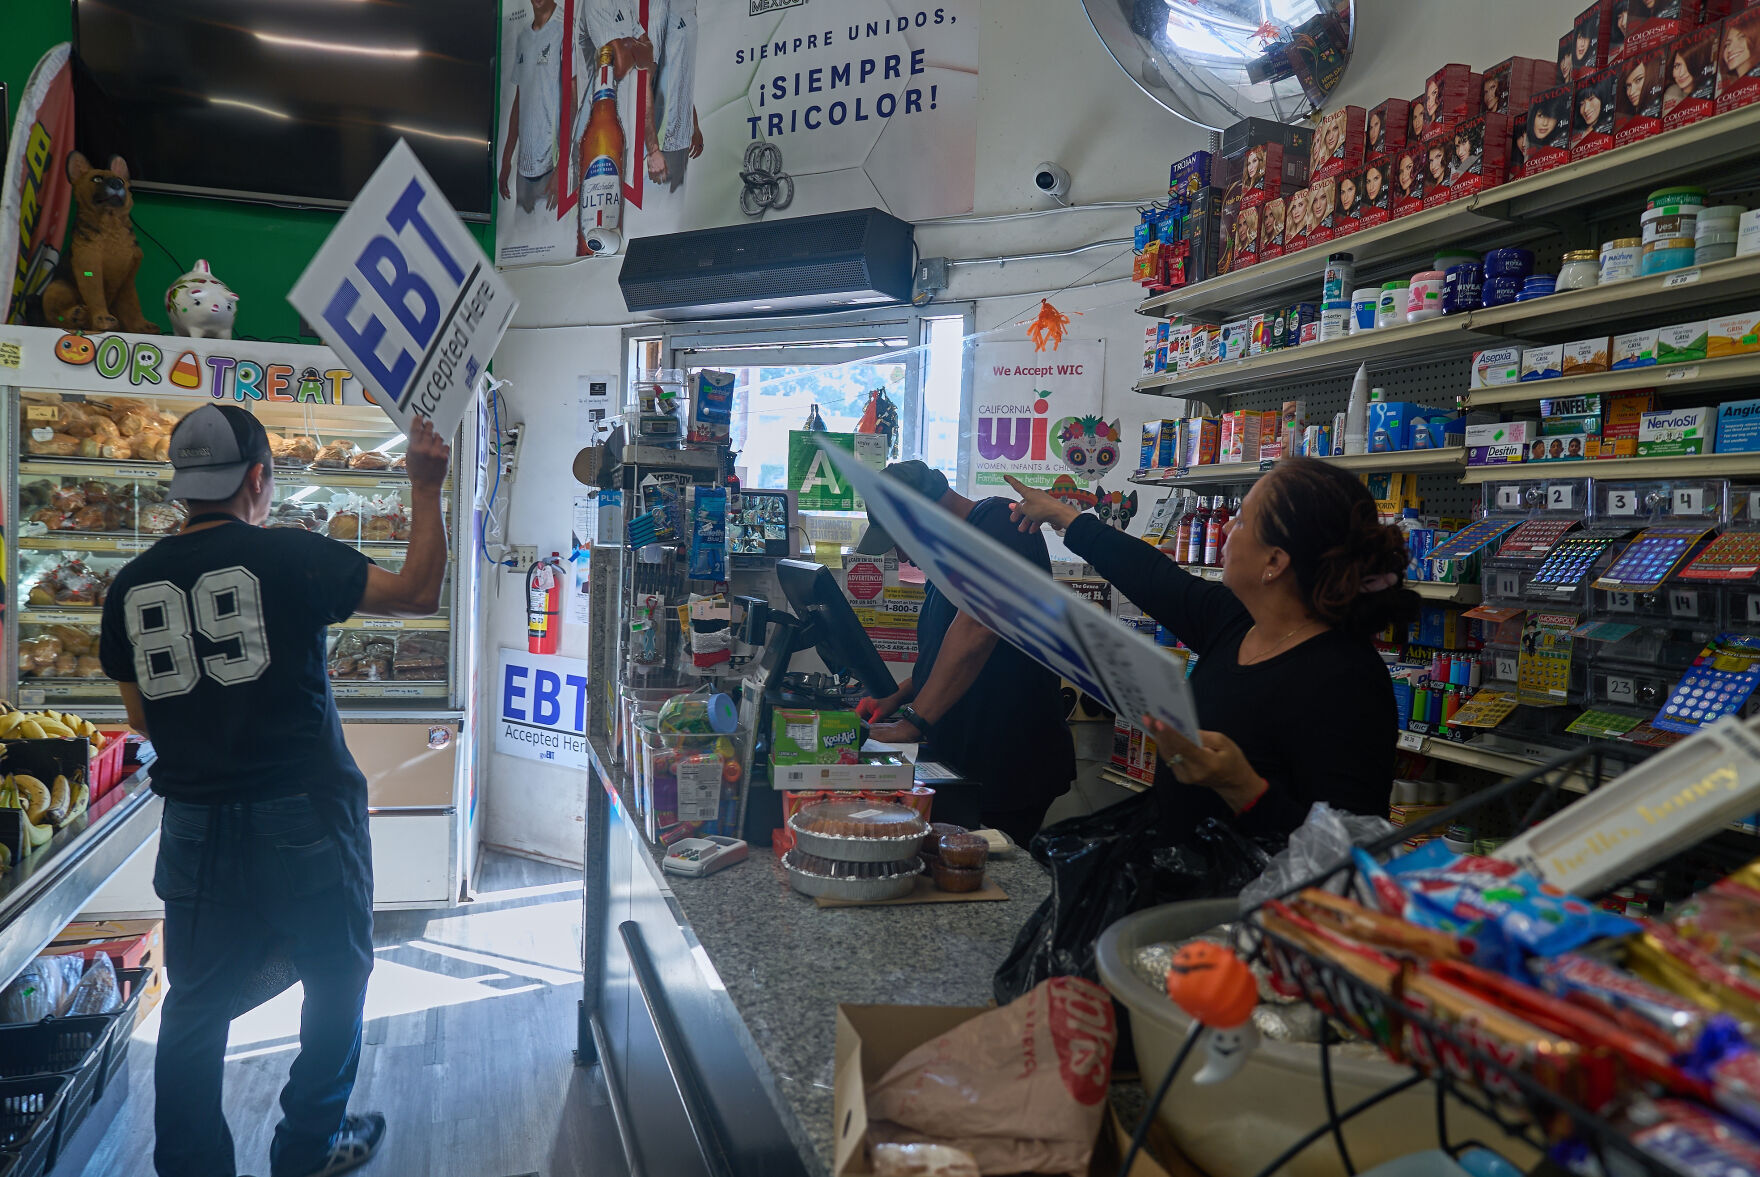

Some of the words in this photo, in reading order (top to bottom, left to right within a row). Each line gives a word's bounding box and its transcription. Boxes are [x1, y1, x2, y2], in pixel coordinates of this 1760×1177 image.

[1575, 4, 1599, 25] REVLON
[735, 31, 833, 64] SIEMPRE
[849, 8, 957, 41] UNIDOS,
[1627, 22, 1675, 43] COLORSILK
[1670, 28, 1717, 53] REVLON
[759, 49, 925, 107] ¡SIEMPRE
[1578, 69, 1617, 89] REVLON
[1531, 86, 1571, 104] REVLON
[1717, 83, 1760, 104] COLORSIL
[747, 85, 938, 139] TRICOLOR!
[1323, 110, 1346, 124] REVLON
[1663, 102, 1709, 123] COLORSILK
[1615, 120, 1656, 140] COLORSILK
[1572, 138, 1610, 154] COLORSILK
[1173, 155, 1197, 172] TROJAN
[1526, 151, 1565, 167] COLORSILK
[1310, 177, 1335, 192] REVLON
[1451, 177, 1479, 192] COLORSILK
[583, 192, 620, 209] ULTRA
[1394, 201, 1420, 214] COLORSILK
[1360, 210, 1386, 223] COLORSILK
[321, 176, 466, 403] EBT
[1726, 325, 1743, 333] GRISI
[411, 314, 468, 421] Accepted
[459, 279, 496, 334] Here
[1479, 349, 1512, 364] Asepxia
[95, 335, 164, 386] OR
[206, 356, 354, 405] TREAT
[993, 366, 1011, 376] We
[1013, 365, 1054, 378] Accept
[1056, 365, 1084, 375] WIC
[978, 404, 1032, 414] CALIFORNIA
[1548, 399, 1587, 416] ZANFEL
[1584, 417, 1597, 431] 30
[1487, 446, 1518, 457] Desitin
[799, 449, 841, 494] A
[976, 462, 1009, 472] WOMEN,
[1010, 463, 1042, 471] INFANTS
[1053, 464, 1071, 472] CHIL
[977, 473, 1004, 483] Families
[1024, 474, 1050, 485] healthy
[1505, 492, 1510, 503] 1
[1553, 489, 1563, 503] 2
[1615, 495, 1626, 509] 3
[1680, 493, 1692, 508] 4
[1375, 501, 1396, 510] PORIN
[1502, 580, 1513, 593] 11
[1611, 592, 1629, 606] 13
[1675, 595, 1692, 611] 14
[884, 604, 919, 613] 1-800-5
[1540, 615, 1576, 625] MONOPOLY
[123, 565, 271, 700] 89
[1499, 662, 1512, 674] 21
[1611, 680, 1631, 695] 23
[503, 664, 588, 732] EBT
[1414, 722, 1426, 731] BIC
[505, 725, 559, 748] Accepted
[563, 736, 588, 753] Her
[822, 729, 857, 748] Kool-Aid
[1636, 761, 1739, 824] honey
